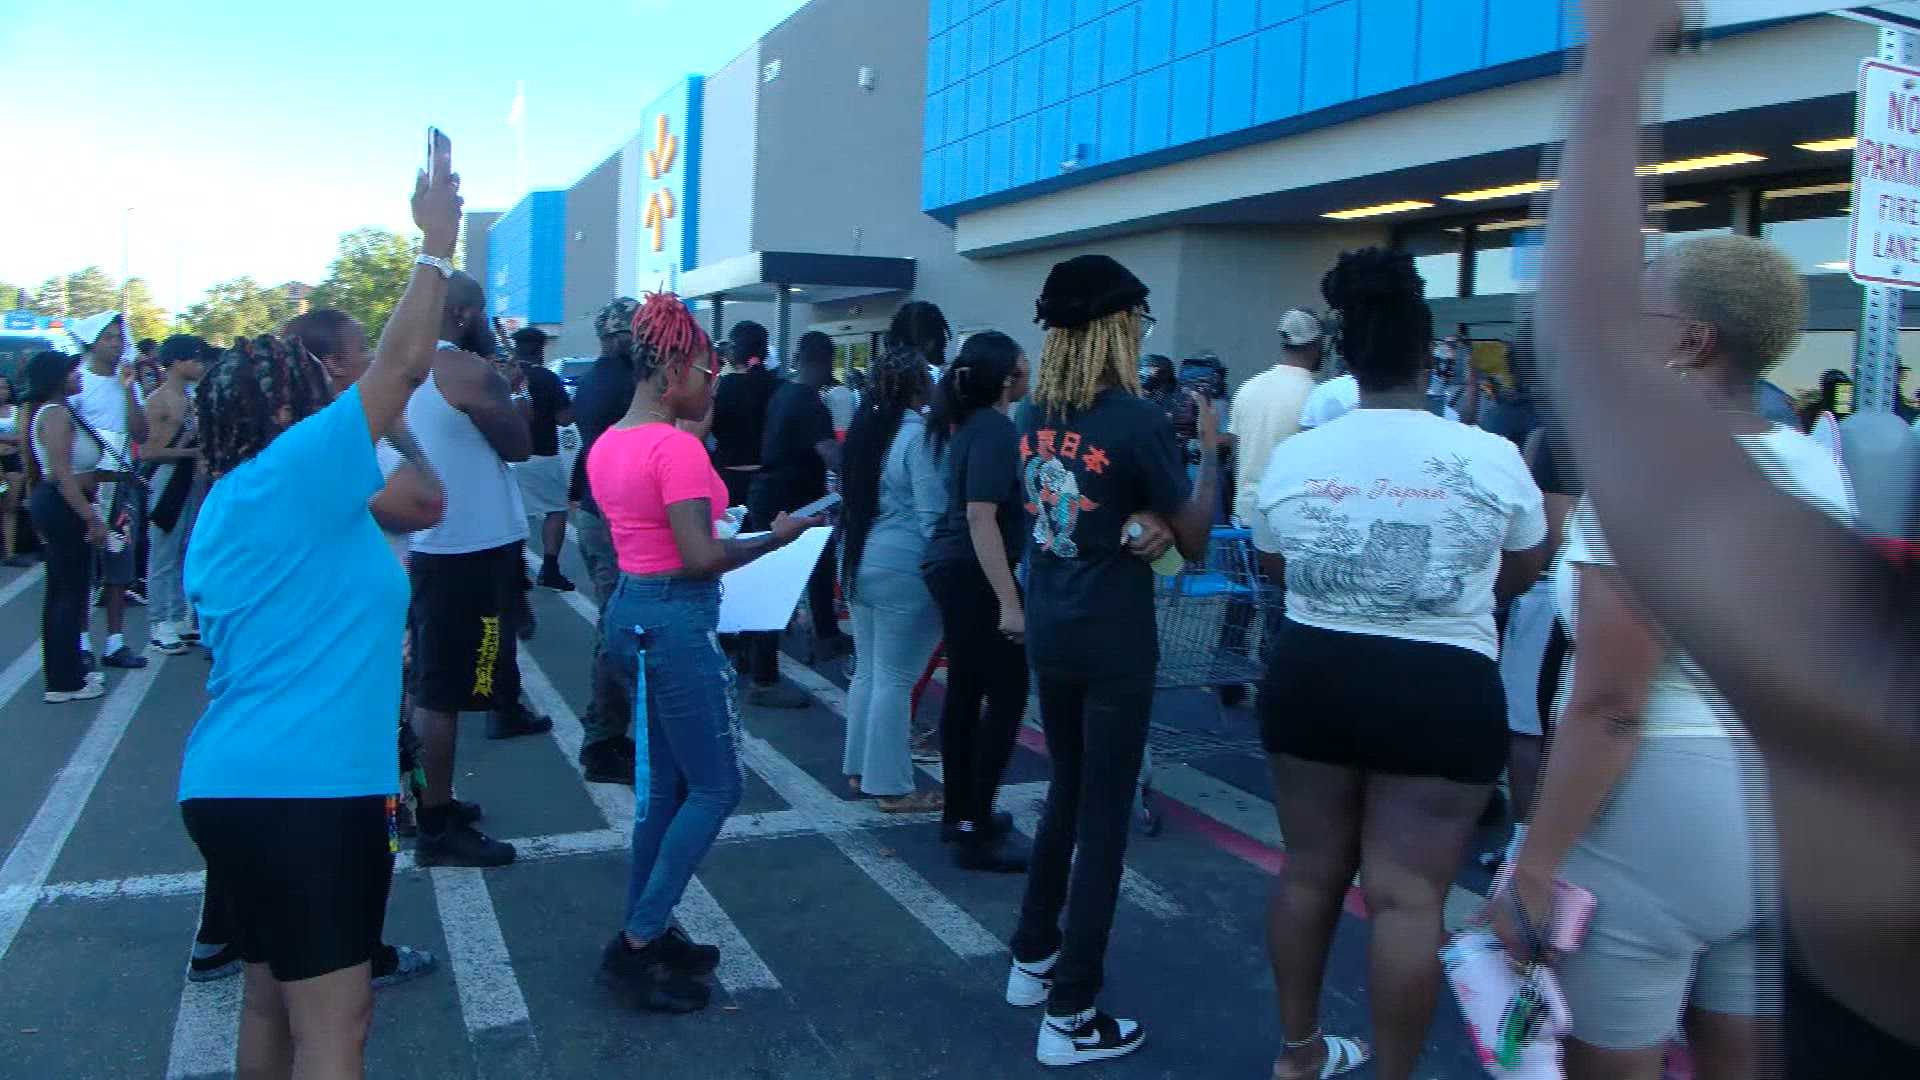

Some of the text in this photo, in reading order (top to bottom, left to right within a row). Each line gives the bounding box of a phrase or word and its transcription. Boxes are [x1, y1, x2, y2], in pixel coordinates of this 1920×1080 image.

[1888, 92, 1920, 133] NO
[1880, 195, 1920, 226] FIRE
[1874, 232, 1920, 263] LANE
[1366, 478, 1449, 507] Japan
